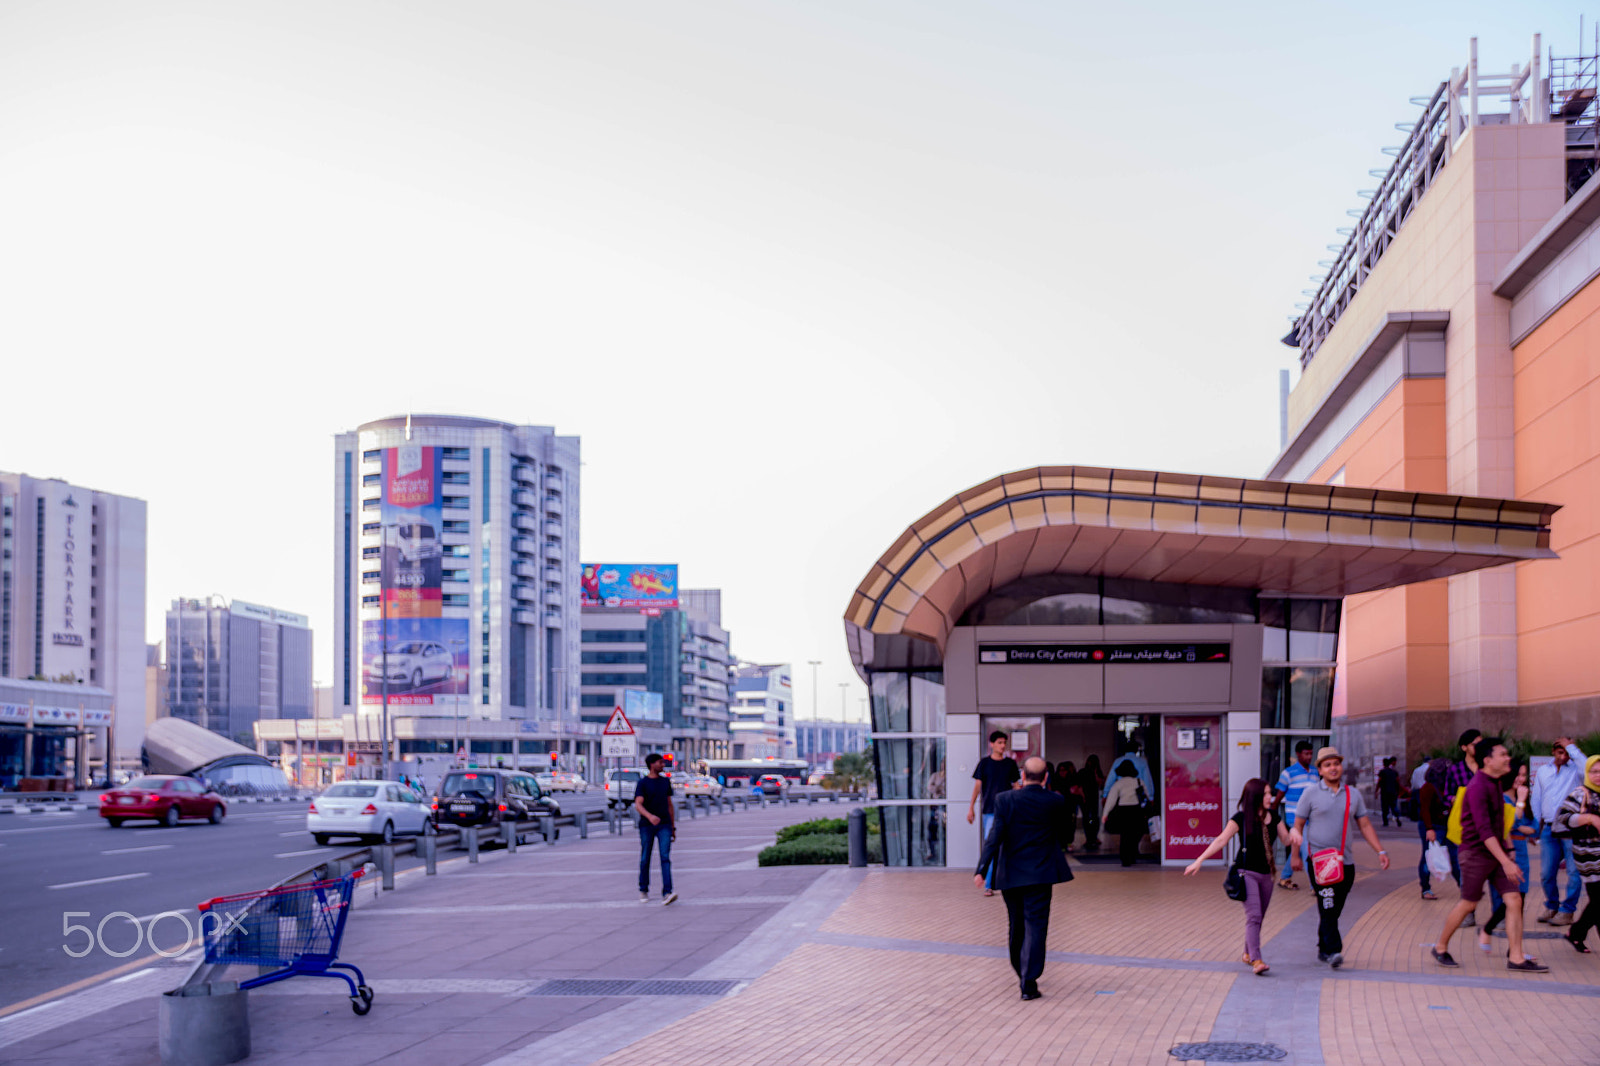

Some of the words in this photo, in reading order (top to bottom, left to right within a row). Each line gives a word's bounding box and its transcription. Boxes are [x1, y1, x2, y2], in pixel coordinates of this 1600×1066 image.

[64, 514, 75, 577] FLORA
[64, 580, 74, 629] PARK
[52, 632, 84, 647] HOTEL
[1010, 650, 1035, 659] Deira
[1036, 650, 1055, 661] City
[1056, 650, 1089, 659] Centre
[1168, 835, 1218, 846] Joyalukka
